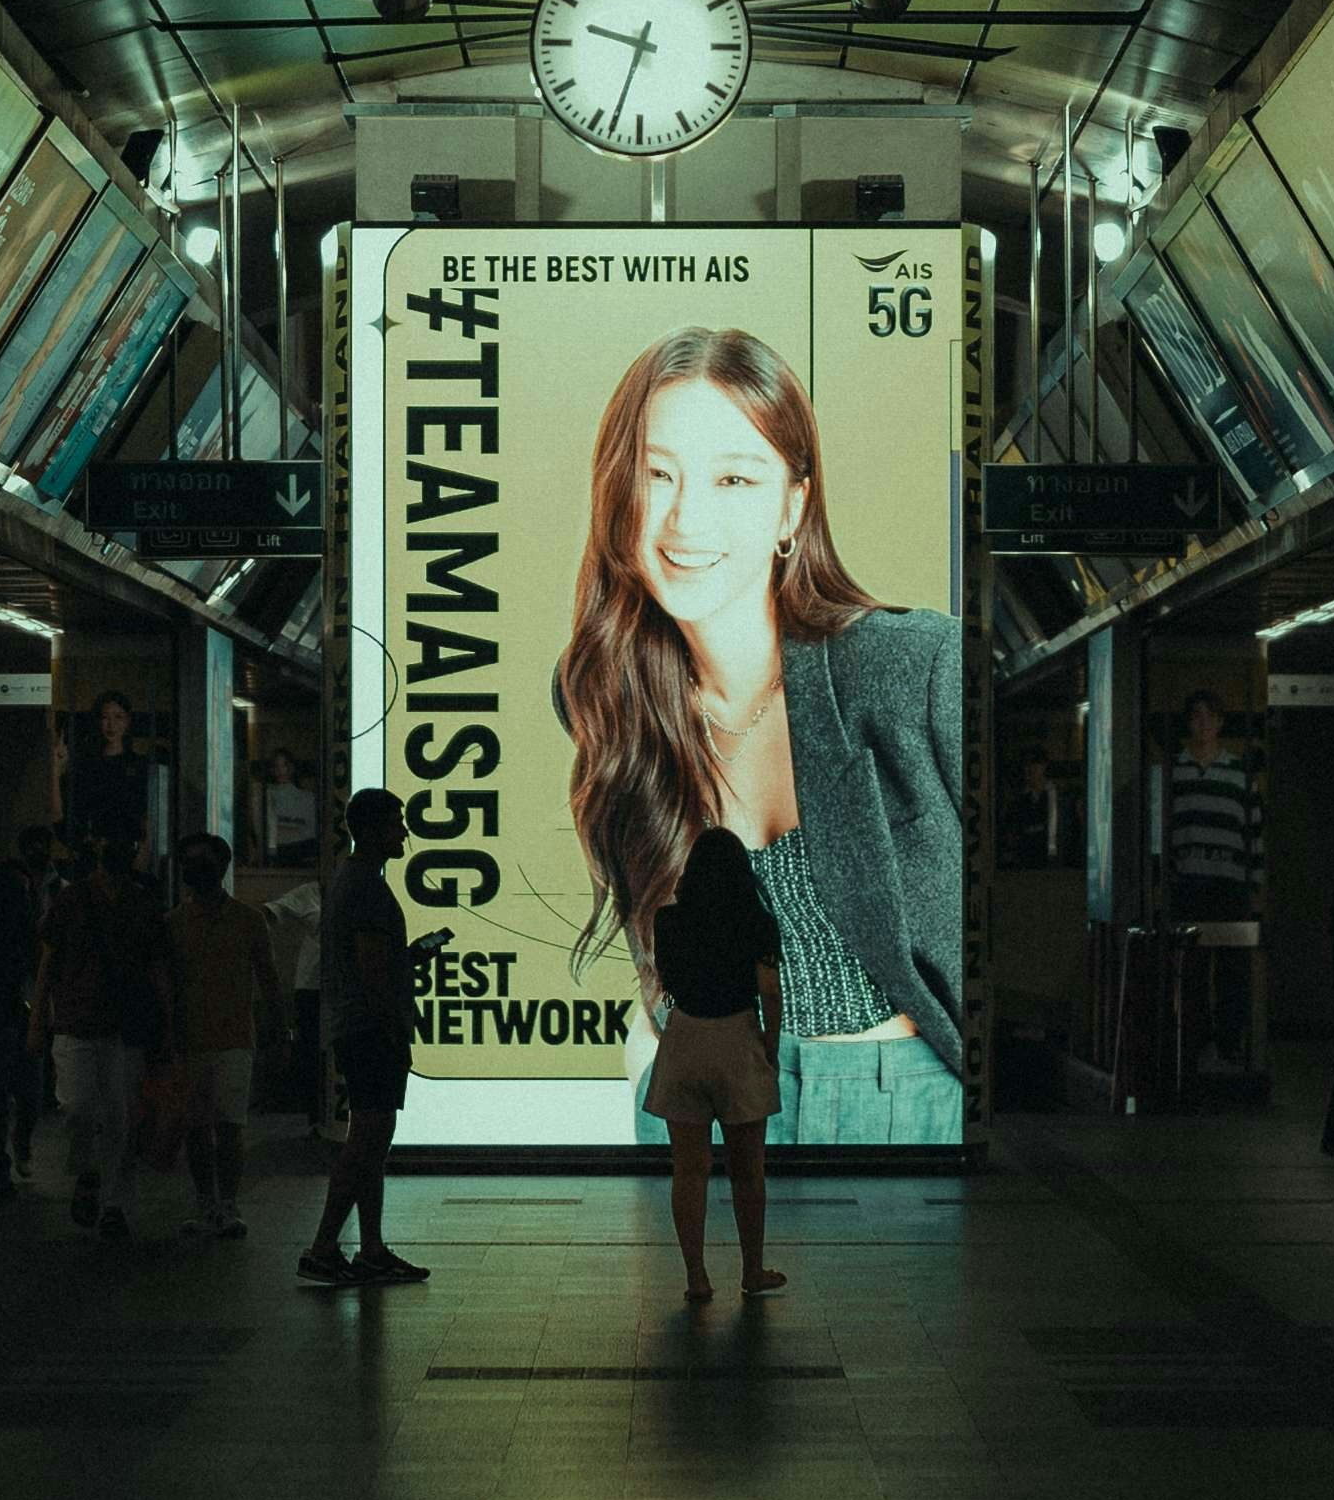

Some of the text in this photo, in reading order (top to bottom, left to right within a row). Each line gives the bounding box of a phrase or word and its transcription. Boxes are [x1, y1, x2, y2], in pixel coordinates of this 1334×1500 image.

[442, 254, 750, 283] BE THE BEST WITH AIS
[895, 263, 933, 280] AIS
[867, 284, 933, 338] 5G
[333, 245, 348, 555] THAILAND
[966, 246, 982, 548] THAILAND
[130, 472, 231, 490] ทางออก
[1026, 474, 1129, 495] ทางออก
[133, 500, 180, 519] Exit
[1030, 503, 1074, 522] Exit
[257, 533, 282, 548] Lift
[404, 286, 501, 907] #TEAMAIS5G
[412, 951, 517, 998] BEST
[410, 999, 635, 1046] NETWORK
